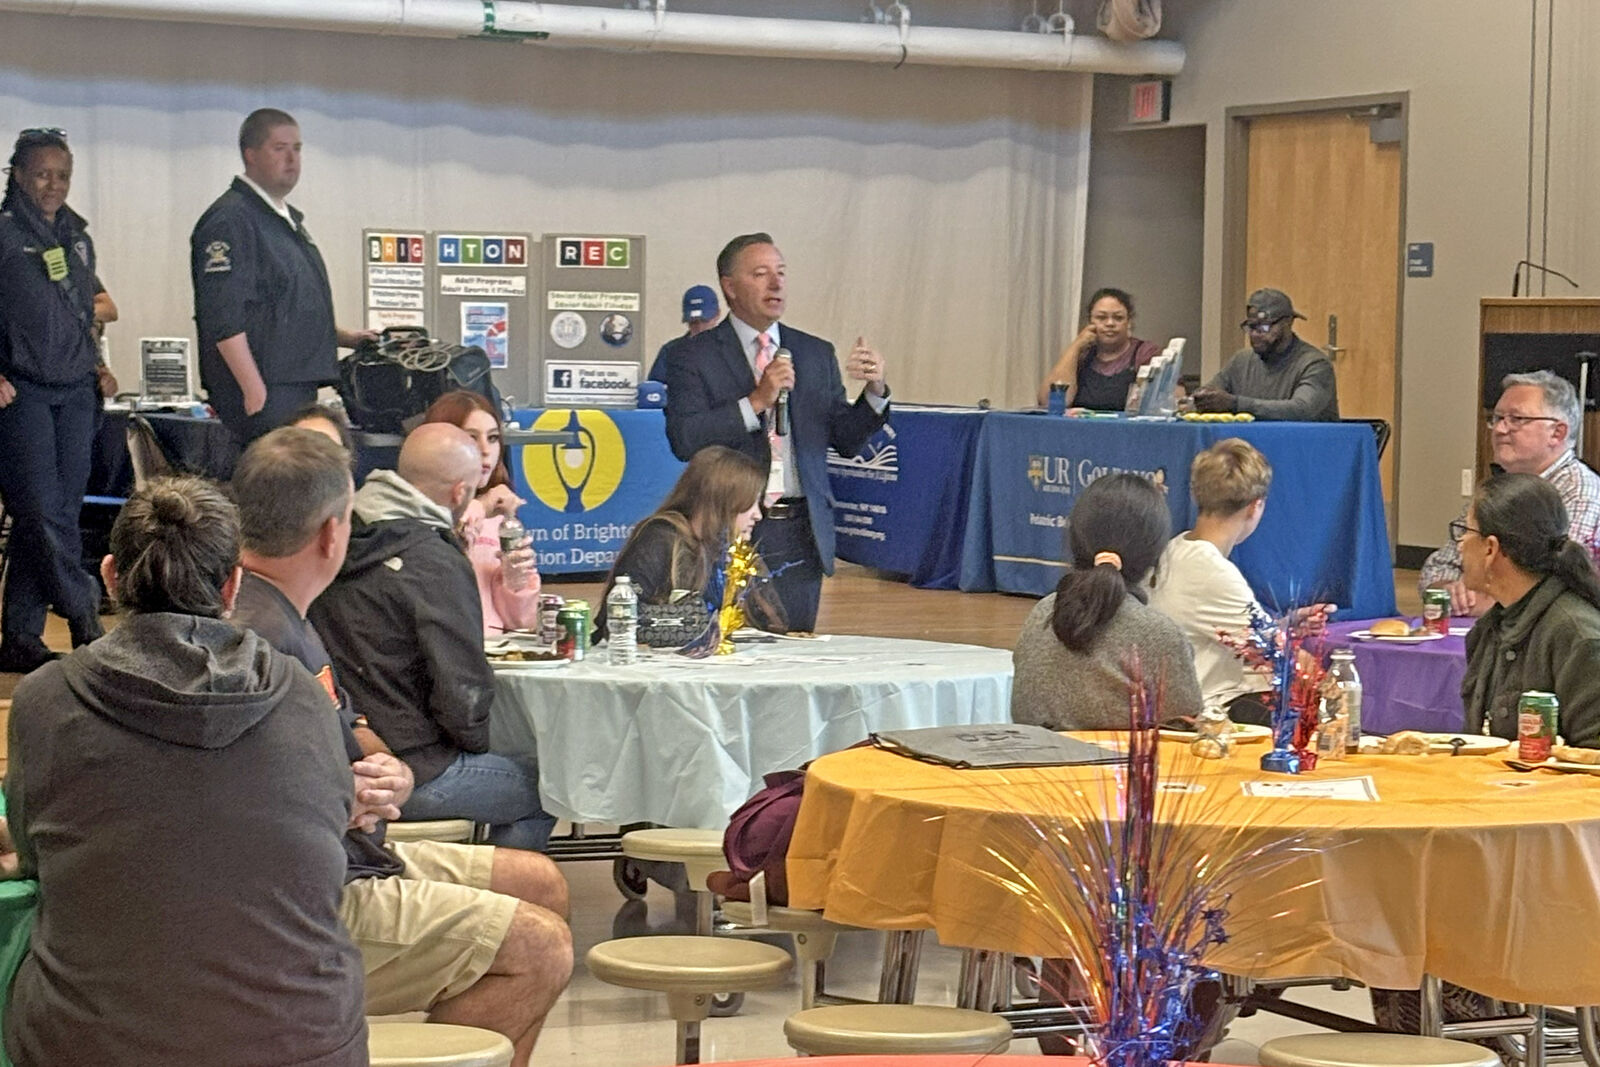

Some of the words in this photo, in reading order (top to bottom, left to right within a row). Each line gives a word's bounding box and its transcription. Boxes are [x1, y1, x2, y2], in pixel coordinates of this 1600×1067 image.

[564, 246, 623, 261] REC
[1044, 456, 1071, 485] UR
[551, 523, 569, 541] of
[573, 522, 637, 544] Brighto
